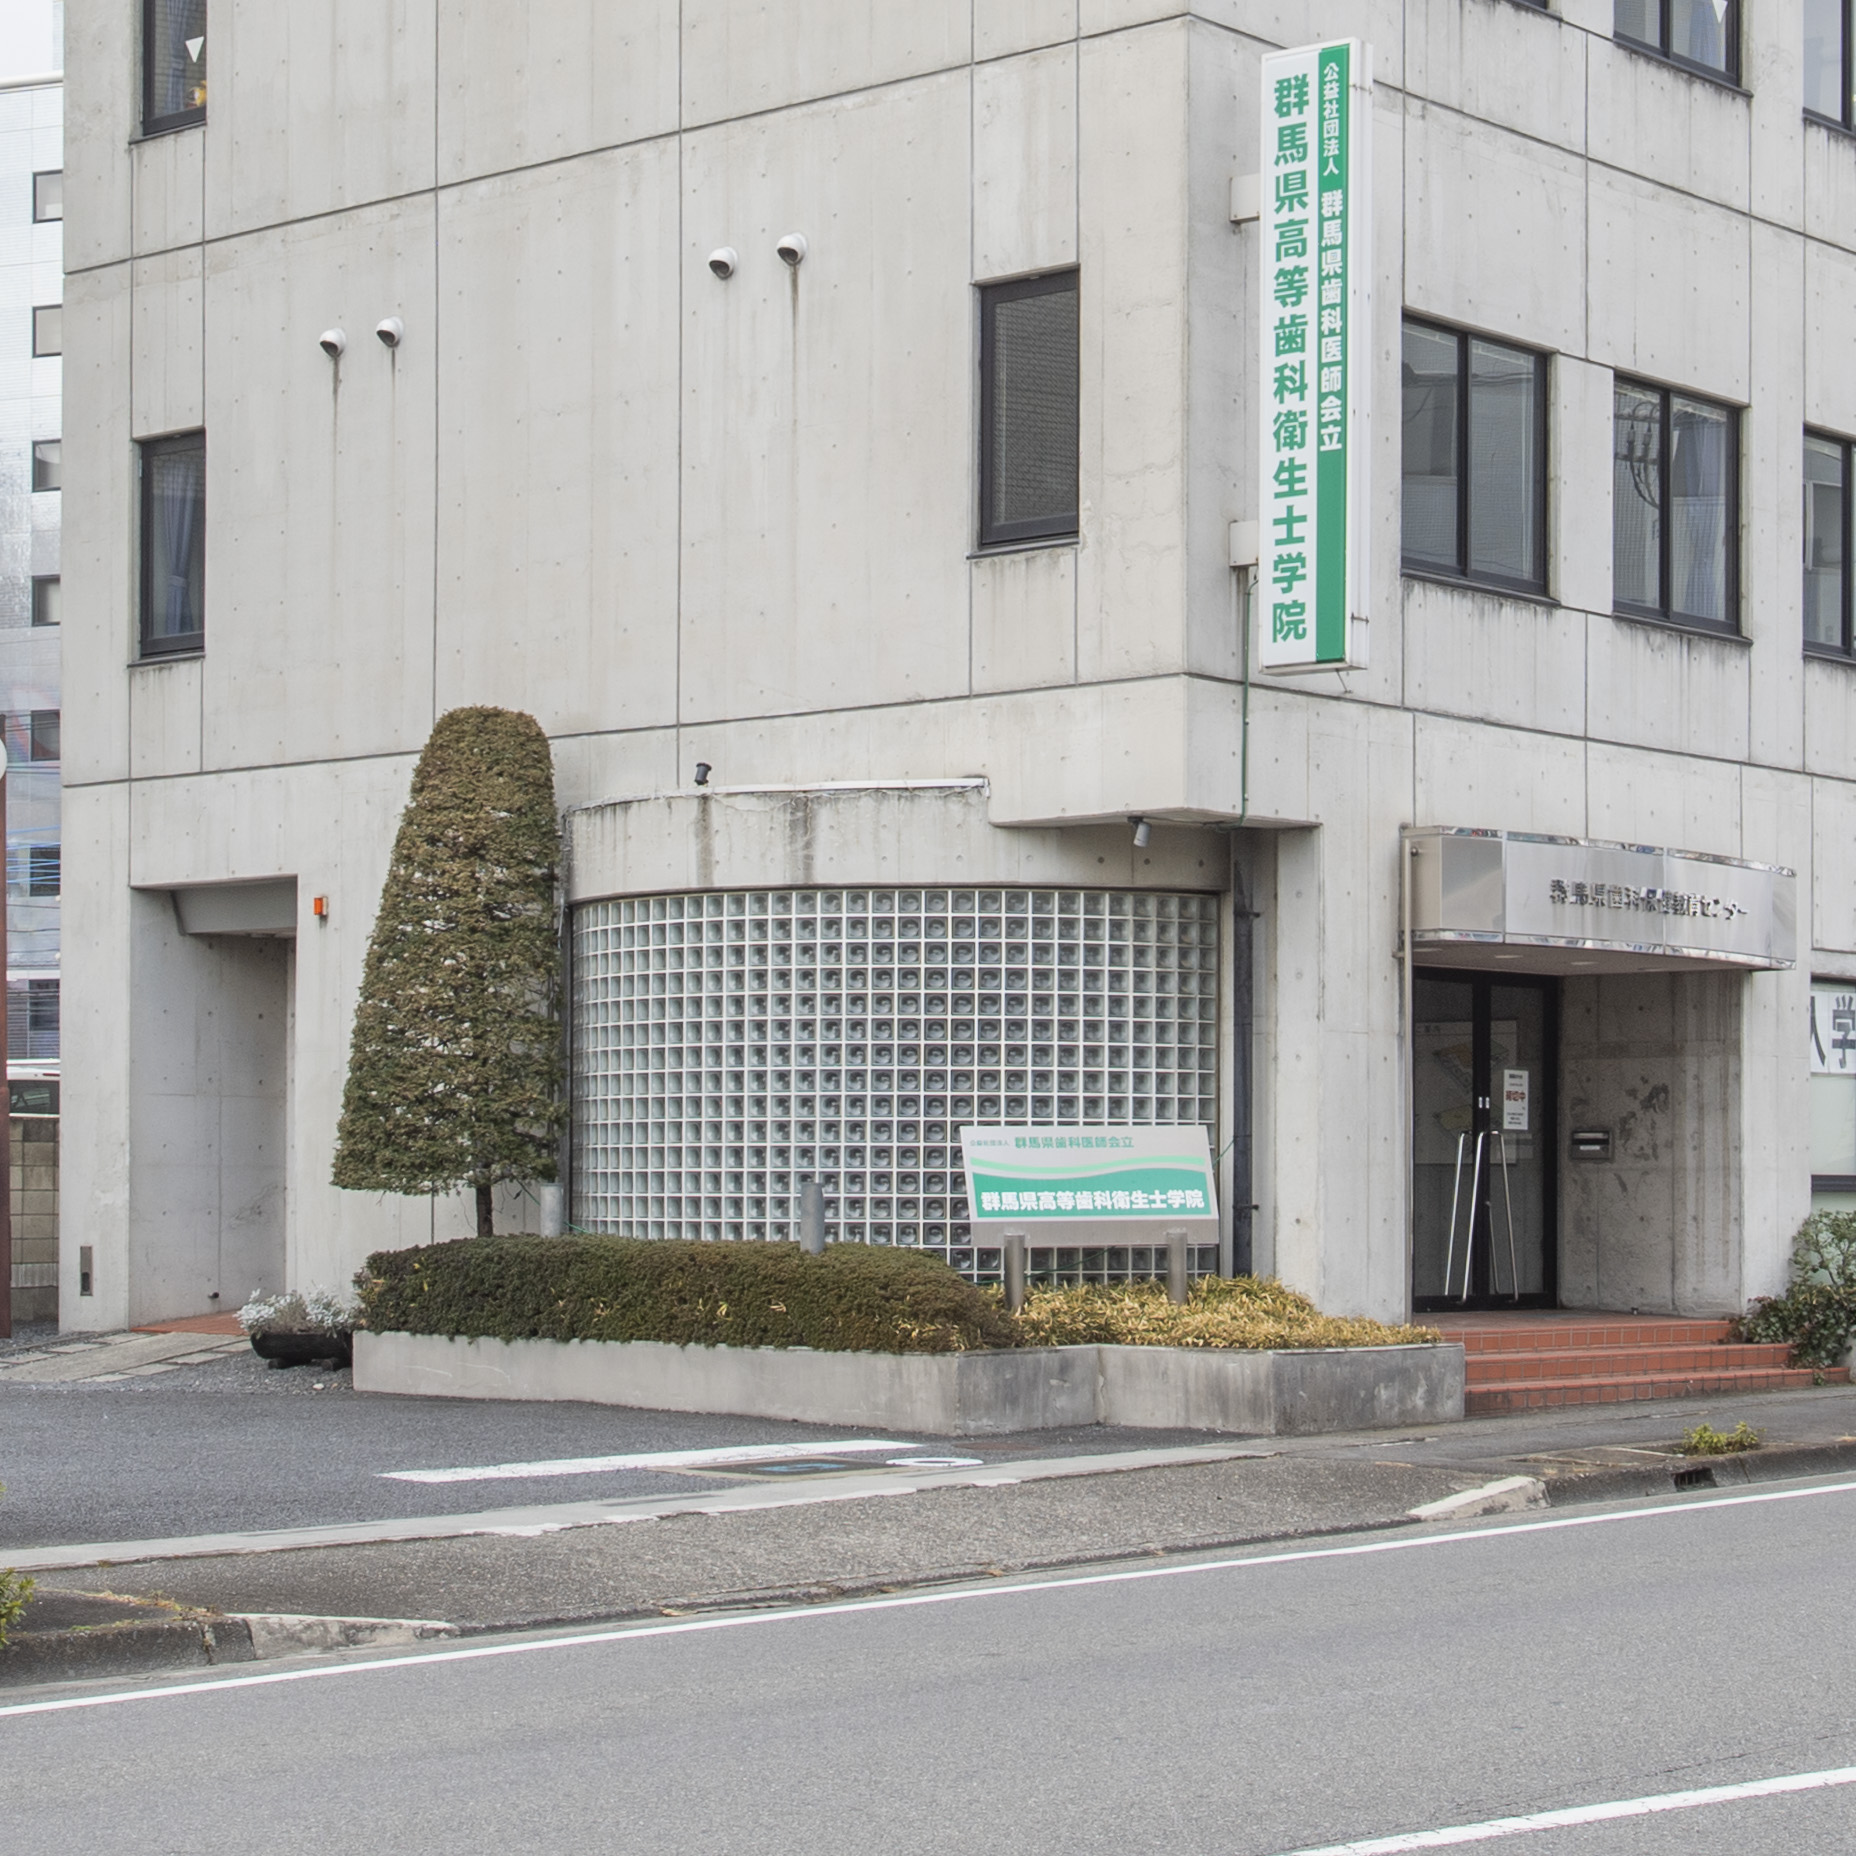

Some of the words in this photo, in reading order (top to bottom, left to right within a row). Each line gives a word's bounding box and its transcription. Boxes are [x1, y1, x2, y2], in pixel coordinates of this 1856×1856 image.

[1322, 62, 1340, 175] 公益社団法人
[1272, 73, 1310, 644] 群馬県高等歯科衛生士学院
[1320, 189, 1343, 452] 群馬県歯科医師会立
[1014, 1136, 1135, 1149] 群馬県歯科医師会立
[980, 1189, 1205, 1211] 群馬県高等歯科衛生士学院
